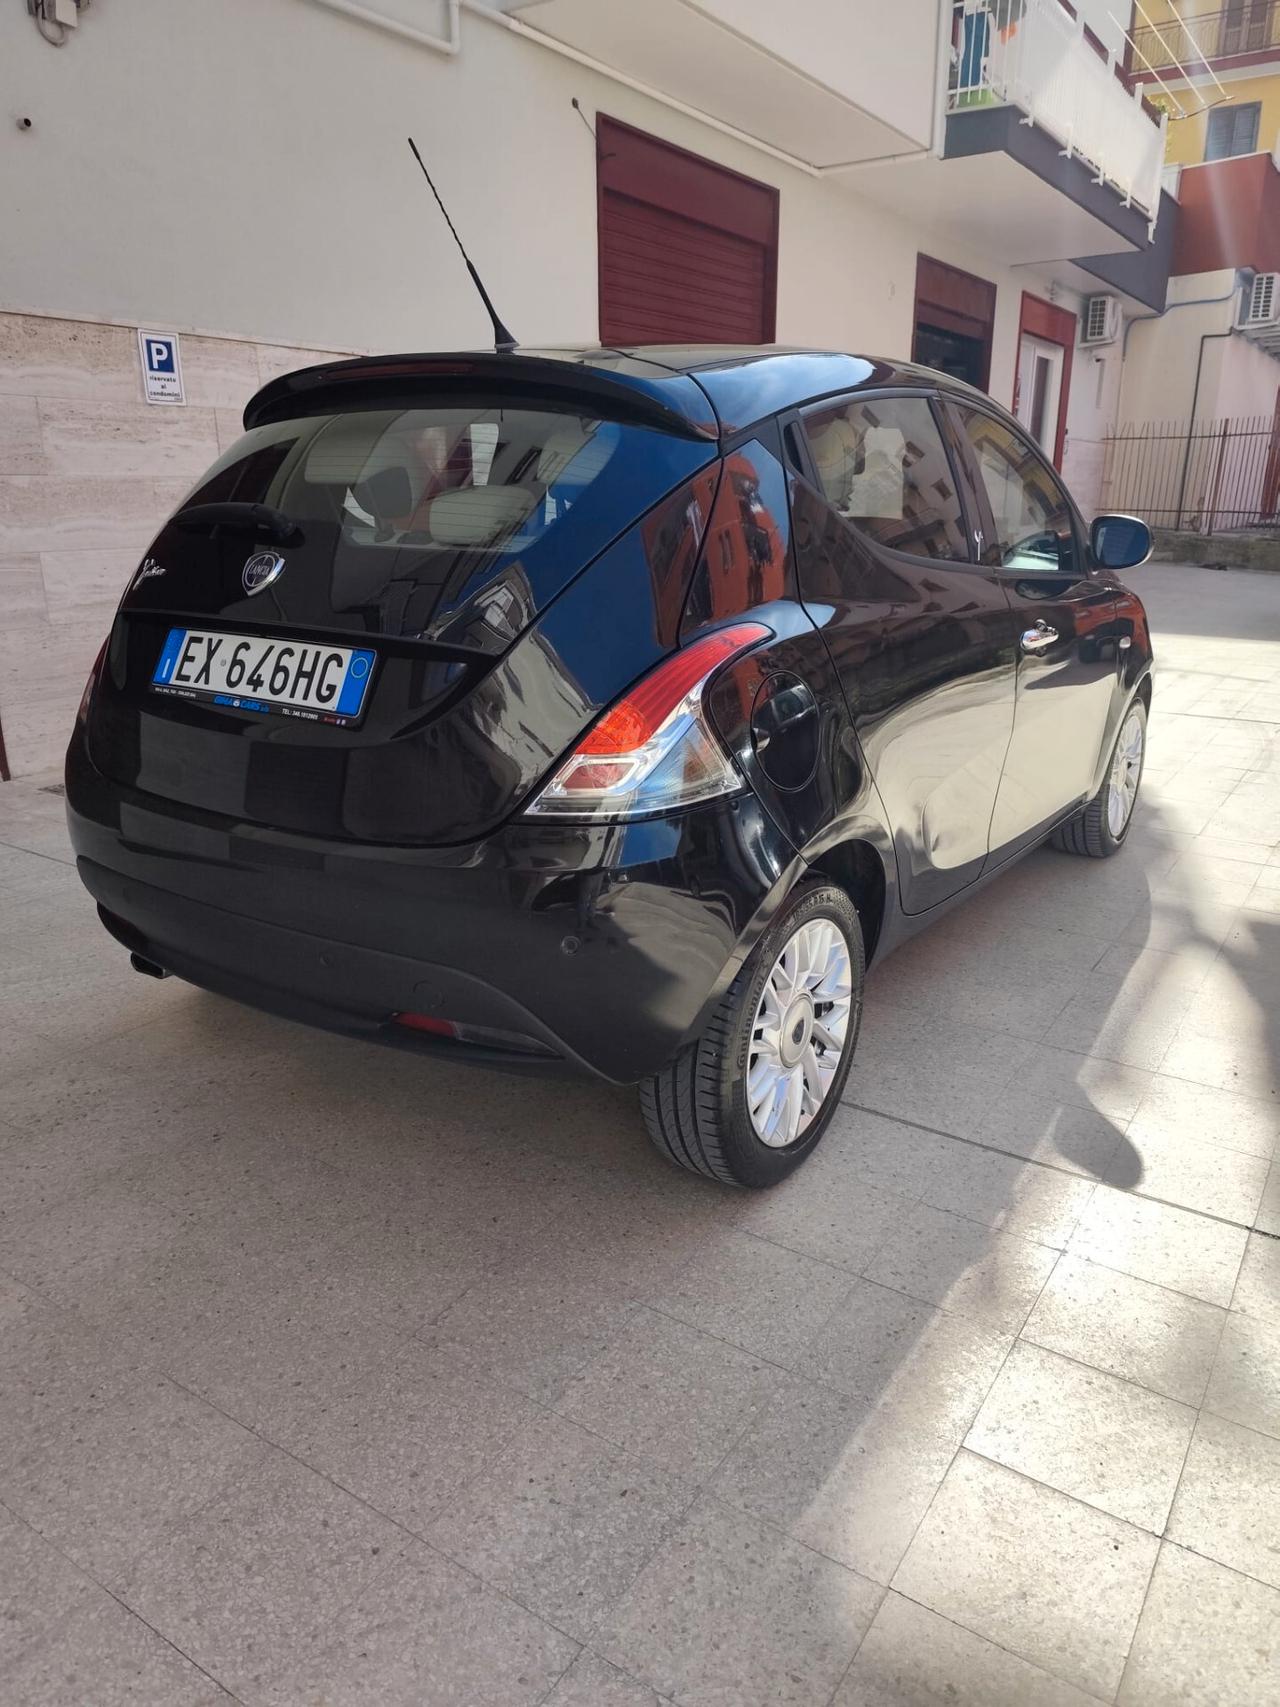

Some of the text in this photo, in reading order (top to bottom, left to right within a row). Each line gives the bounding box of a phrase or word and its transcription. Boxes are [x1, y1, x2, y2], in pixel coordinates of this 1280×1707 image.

[150, 342, 168, 369] P
[175, 637, 343, 703] EX 646HG
